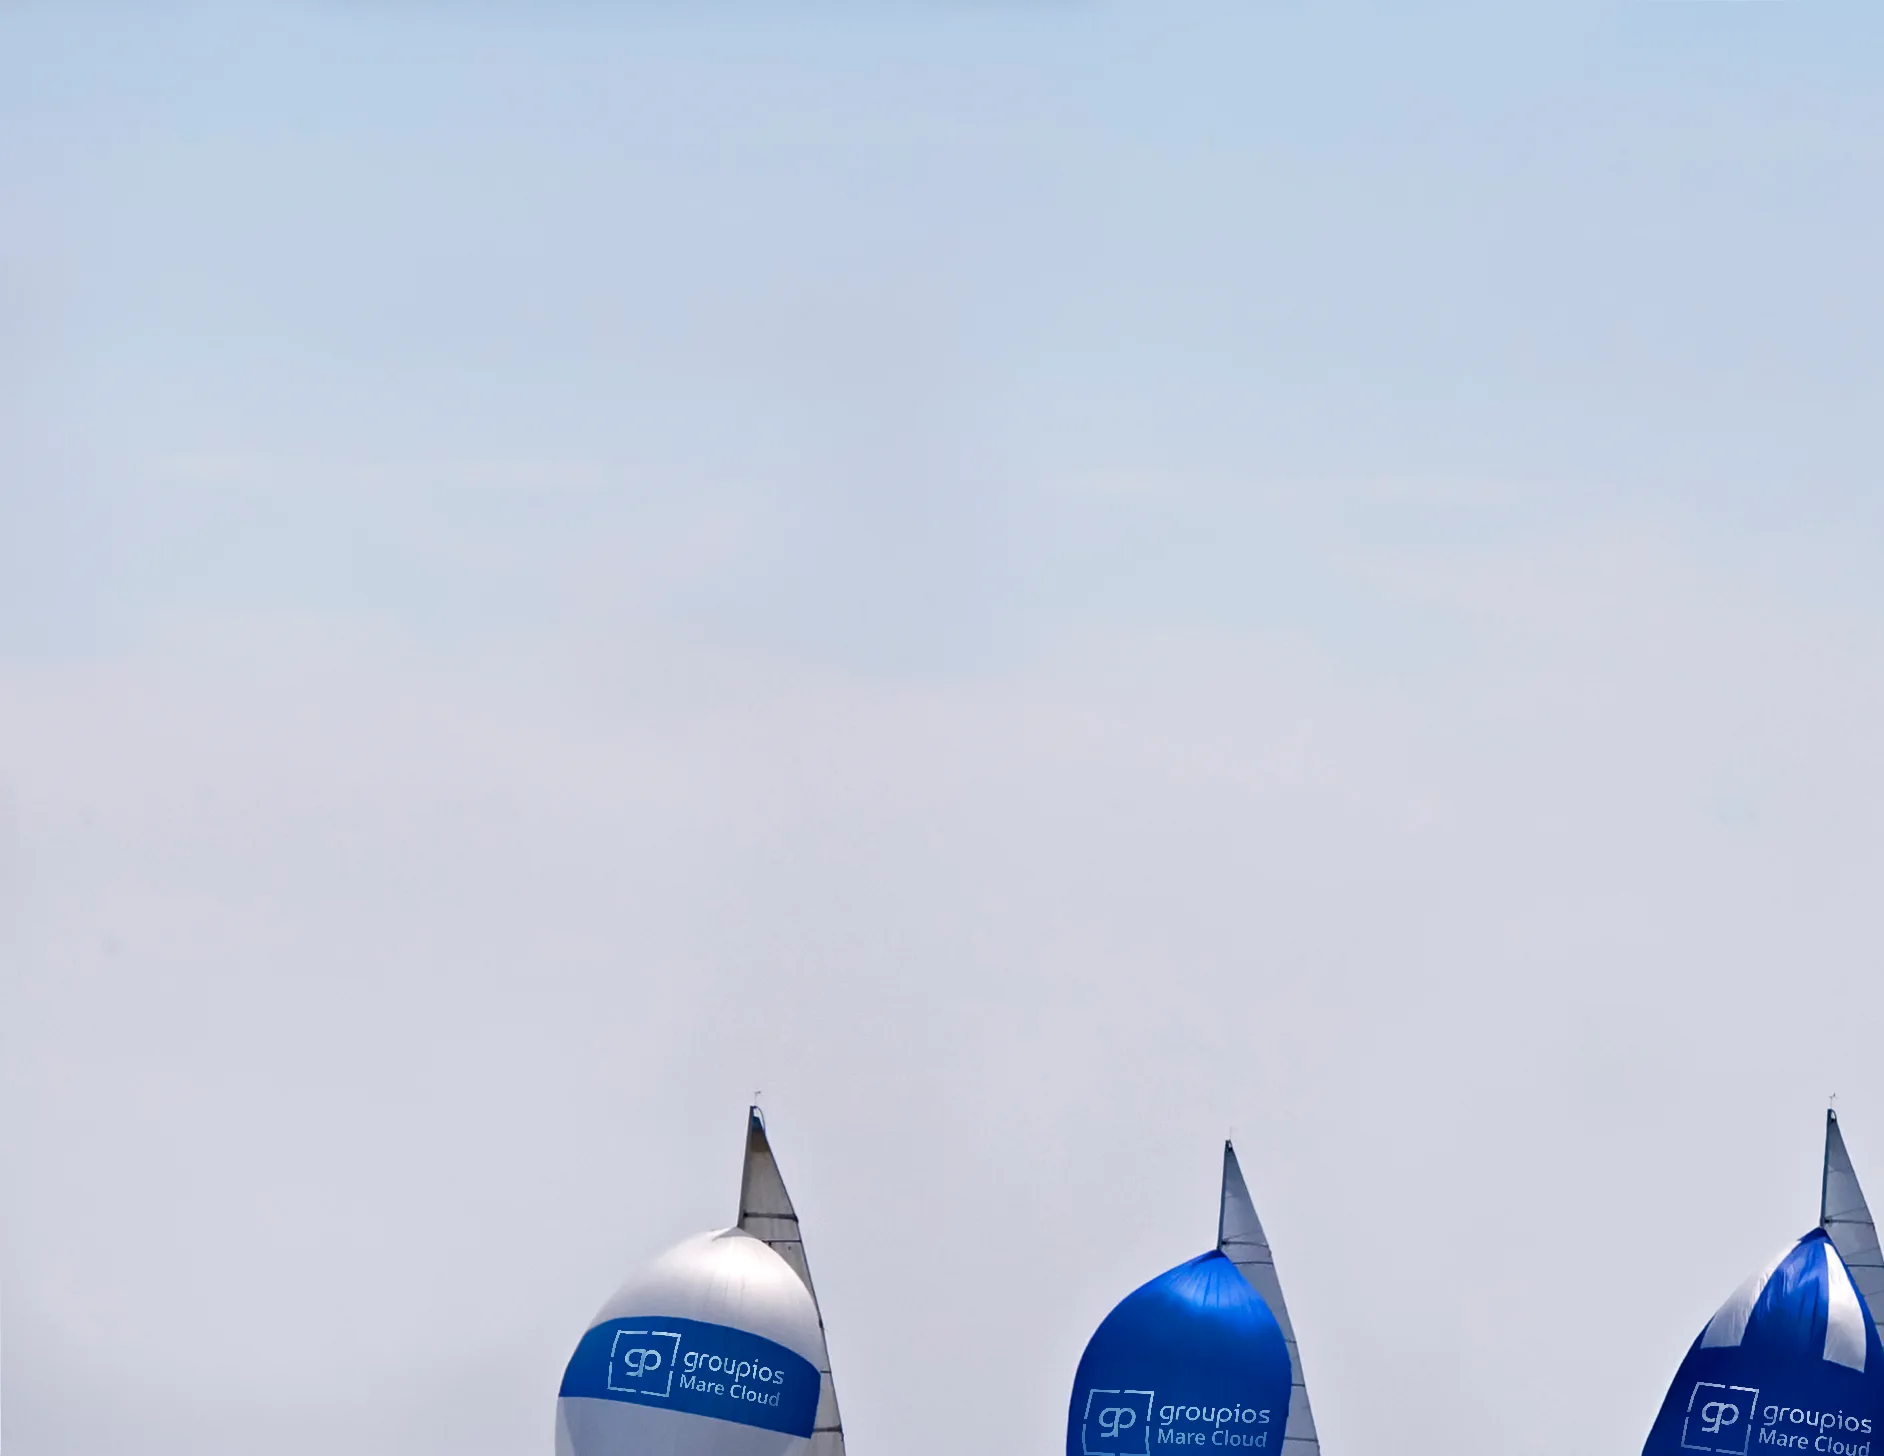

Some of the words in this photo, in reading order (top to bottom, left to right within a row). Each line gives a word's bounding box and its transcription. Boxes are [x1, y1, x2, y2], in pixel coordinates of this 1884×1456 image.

[683, 1351, 785, 1385] groupios
[679, 1373, 725, 1396] Mare
[729, 1384, 781, 1407] Cloud
[1159, 1403, 1271, 1429] groupios
[1763, 1405, 1872, 1434] groupios
[1157, 1428, 1206, 1446] Mare
[1211, 1430, 1268, 1448] Cloud
[1758, 1427, 1809, 1450] Mare
